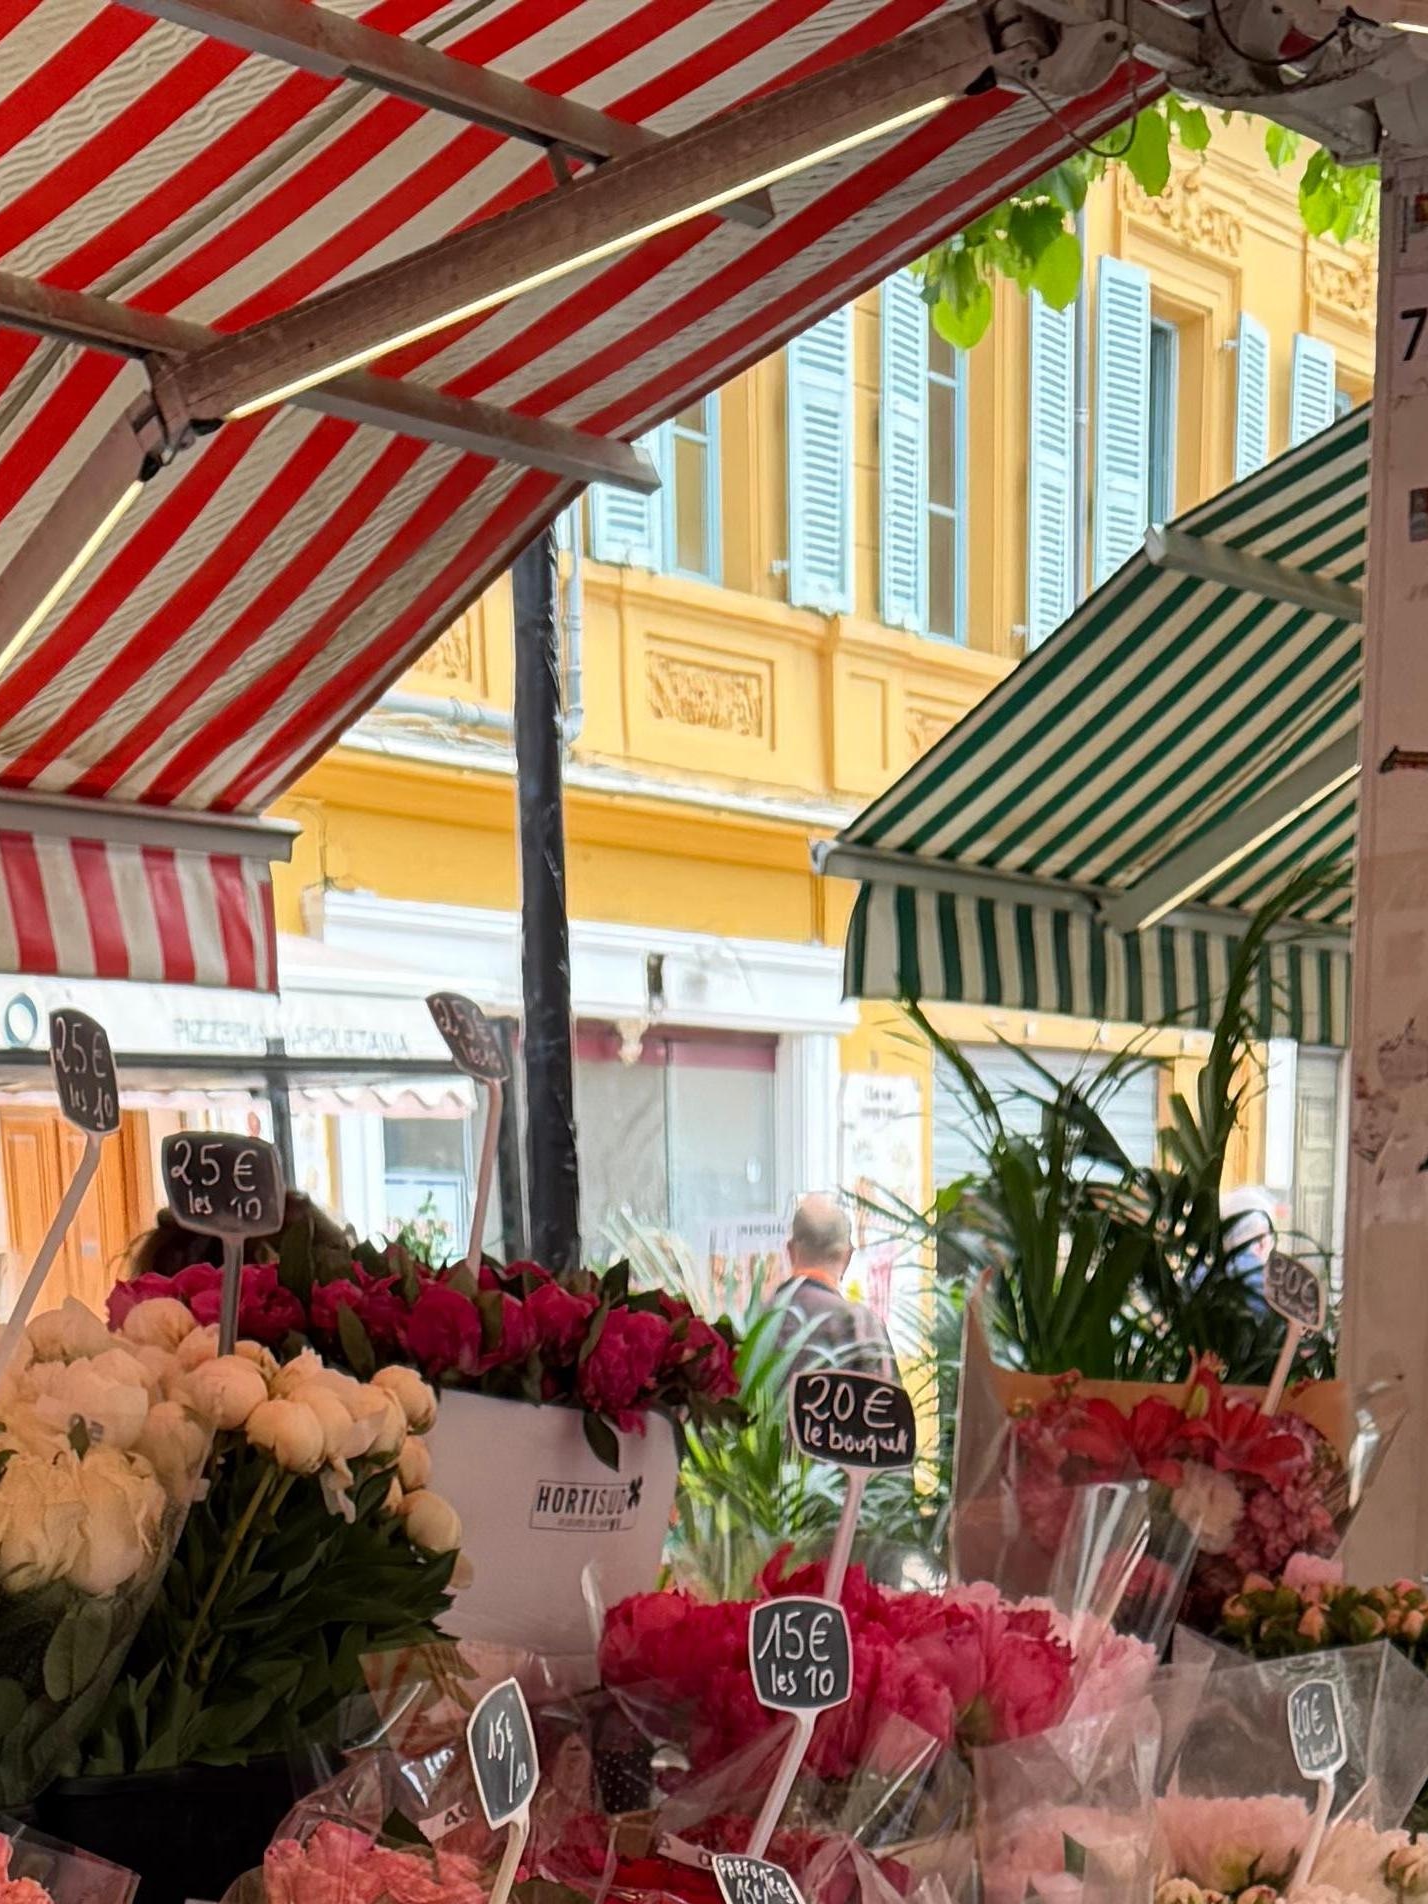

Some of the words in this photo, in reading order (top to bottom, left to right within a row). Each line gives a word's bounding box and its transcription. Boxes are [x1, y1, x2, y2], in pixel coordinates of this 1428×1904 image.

[188, 1190, 212, 1215] les
[803, 1416, 823, 1447] le
[757, 1611, 833, 1662] 15€
[771, 1663, 797, 1696] les
[804, 1665, 835, 1698] 10
